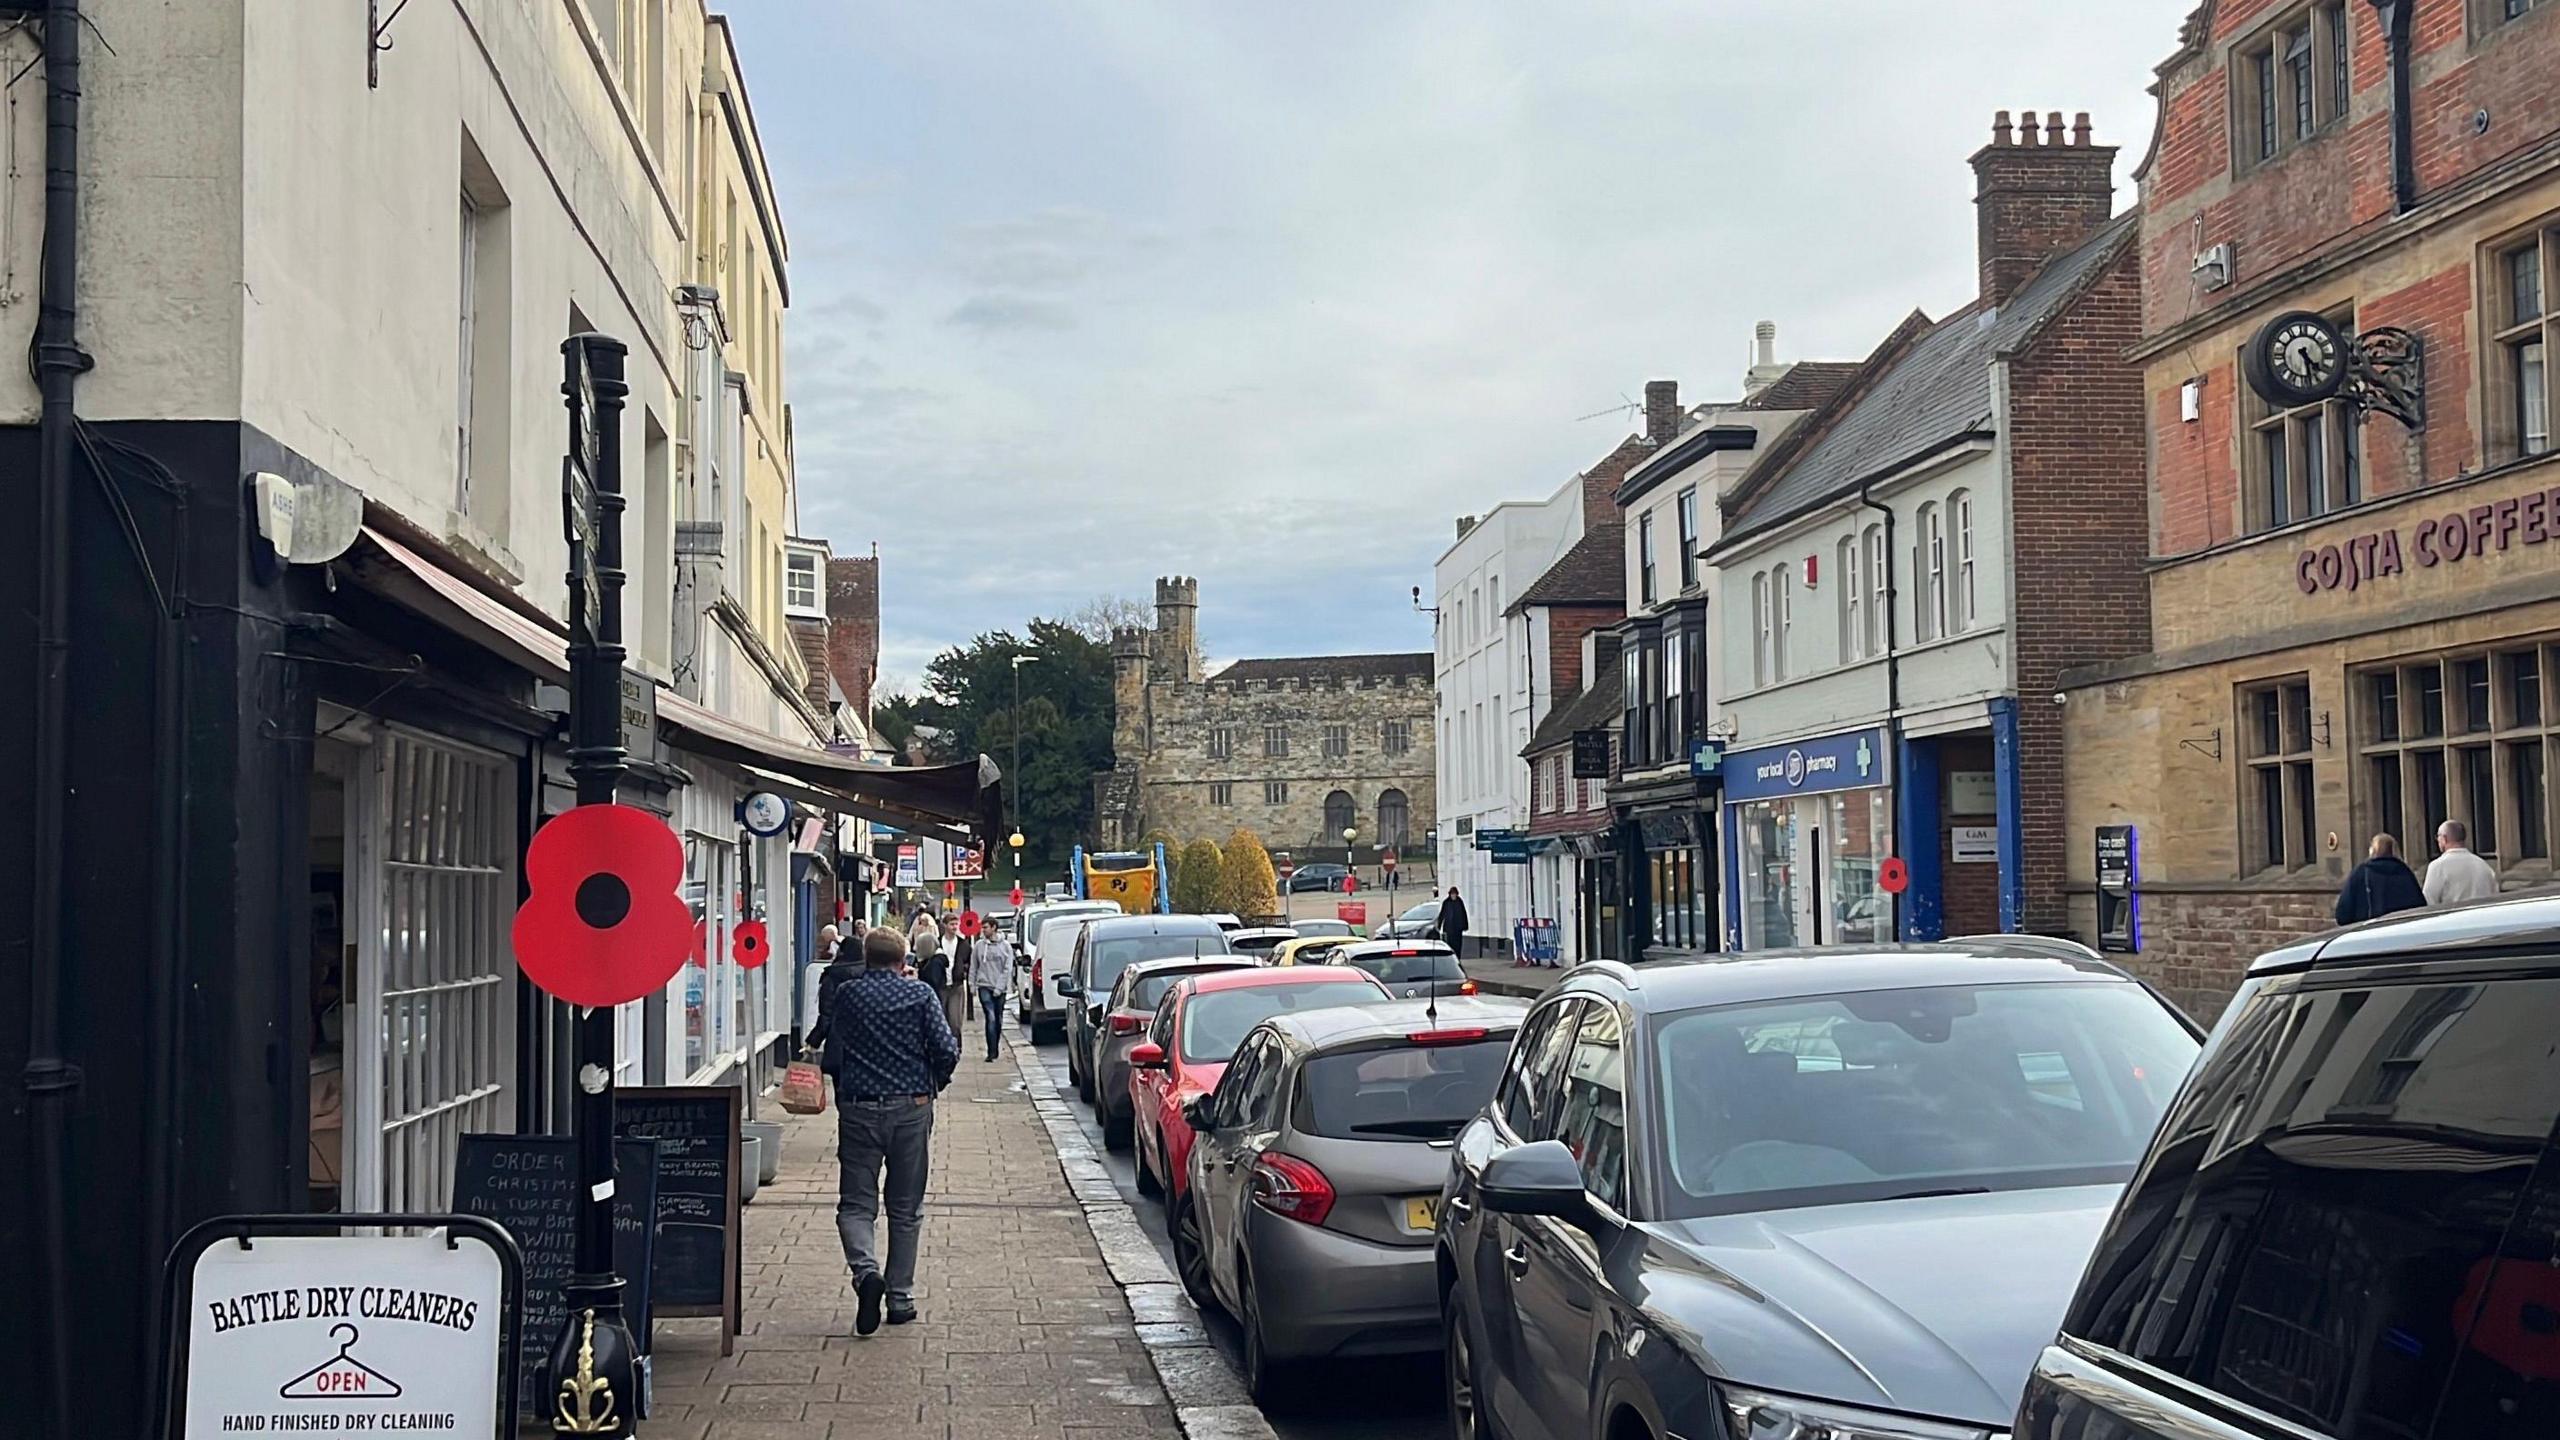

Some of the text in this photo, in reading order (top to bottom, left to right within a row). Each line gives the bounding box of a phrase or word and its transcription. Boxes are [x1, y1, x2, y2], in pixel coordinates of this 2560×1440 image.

[2296, 529, 2402, 594] COSTA
[1757, 766, 1769, 784] your
[1769, 760, 1784, 777] local
[1806, 755, 1836, 775] pharmacy
[492, 1152, 566, 1172] ORDER
[545, 1214, 576, 1228] BAT
[209, 1286, 478, 1332] BATTLE DRY CLEANERS
[317, 1372, 367, 1392] OPEN
[223, 1413, 455, 1431] HAND FINISHED DRY CLEANING
